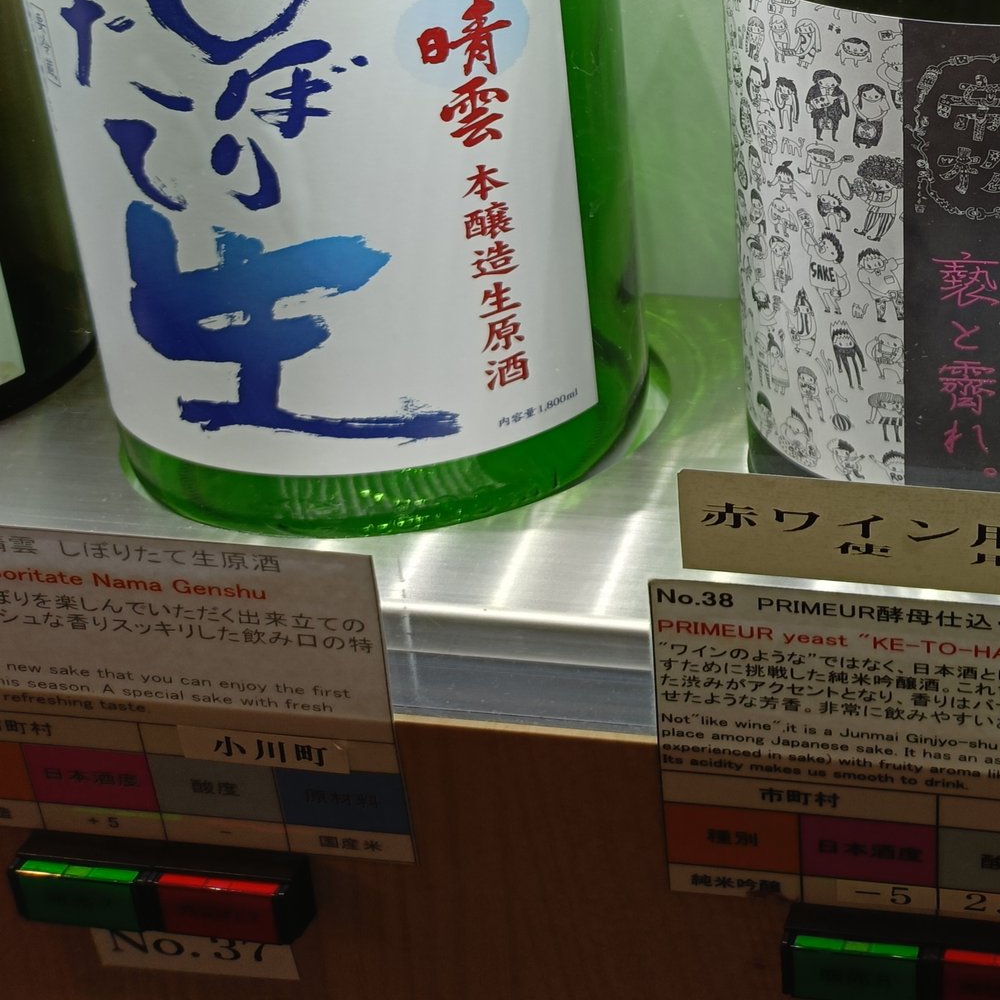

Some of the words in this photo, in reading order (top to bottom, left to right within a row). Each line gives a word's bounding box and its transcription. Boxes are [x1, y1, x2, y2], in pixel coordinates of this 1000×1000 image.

[462, 164, 530, 391] 本醸造生原酒
[810, 260, 836, 283] SAKE
[59, 540, 281, 573] しぼりたて生原酒
[0, 567, 83, 585] oritate
[92, 572, 162, 592] Nama
[172, 578, 267, 600] Genshu
[656, 587, 735, 609] No.38
[657, 619, 774, 640] PRIMEUR
[783, 632, 849, 651] yeast
[7, 662, 42, 673] new
[50, 665, 91, 677] sake
[97, 668, 135, 681] that
[141, 673, 173, 684] you
[180, 677, 212, 687] can
[219, 679, 267, 694] enjoy
[276, 683, 305, 695] the
[313, 685, 351, 699] first
[4, 692, 94, 710] refreshing
[103, 683, 115, 695] A
[123, 686, 184, 701] special
[191, 693, 233, 705] sake
[240, 698, 279, 709] with
[286, 699, 334, 713] fresh
[0, 719, 53, 737] 町村
[804, 724, 817, 735] is
[824, 728, 833, 736] a
[839, 727, 899, 743] Junmai
[214, 735, 328, 768] 小川町
[662, 727, 705, 741] place
[711, 731, 765, 746] among
[770, 736, 850, 755] Japanese
[856, 744, 898, 757] sake.
[904, 746, 917, 758] It
[922, 748, 952, 760] has
[958, 752, 978, 762] an
[662, 743, 762, 759] experienced
[768, 748, 783, 760] in
[788, 752, 833, 766] sake)
[838, 756, 874, 769] with
[878, 759, 924, 775] fruity
[929, 765, 982, 779] aroma
[662, 753, 683, 765] Its
[689, 757, 745, 772] acidity
[750, 762, 802, 777] makes
[808, 768, 827, 778] us
[833, 770, 895, 785] smooth
[901, 774, 918, 786] to
[924, 776, 970, 792] drink.
[43, 767, 140, 788] 日本酒度
[191, 779, 240, 797] 酸度
[758, 787, 841, 809] 市町村
[318, 835, 383, 852] 国産米
[706, 827, 759, 848] 種別
[817, 839, 925, 863] 日本酒度
[690, 873, 782, 895] 純米吟醸
